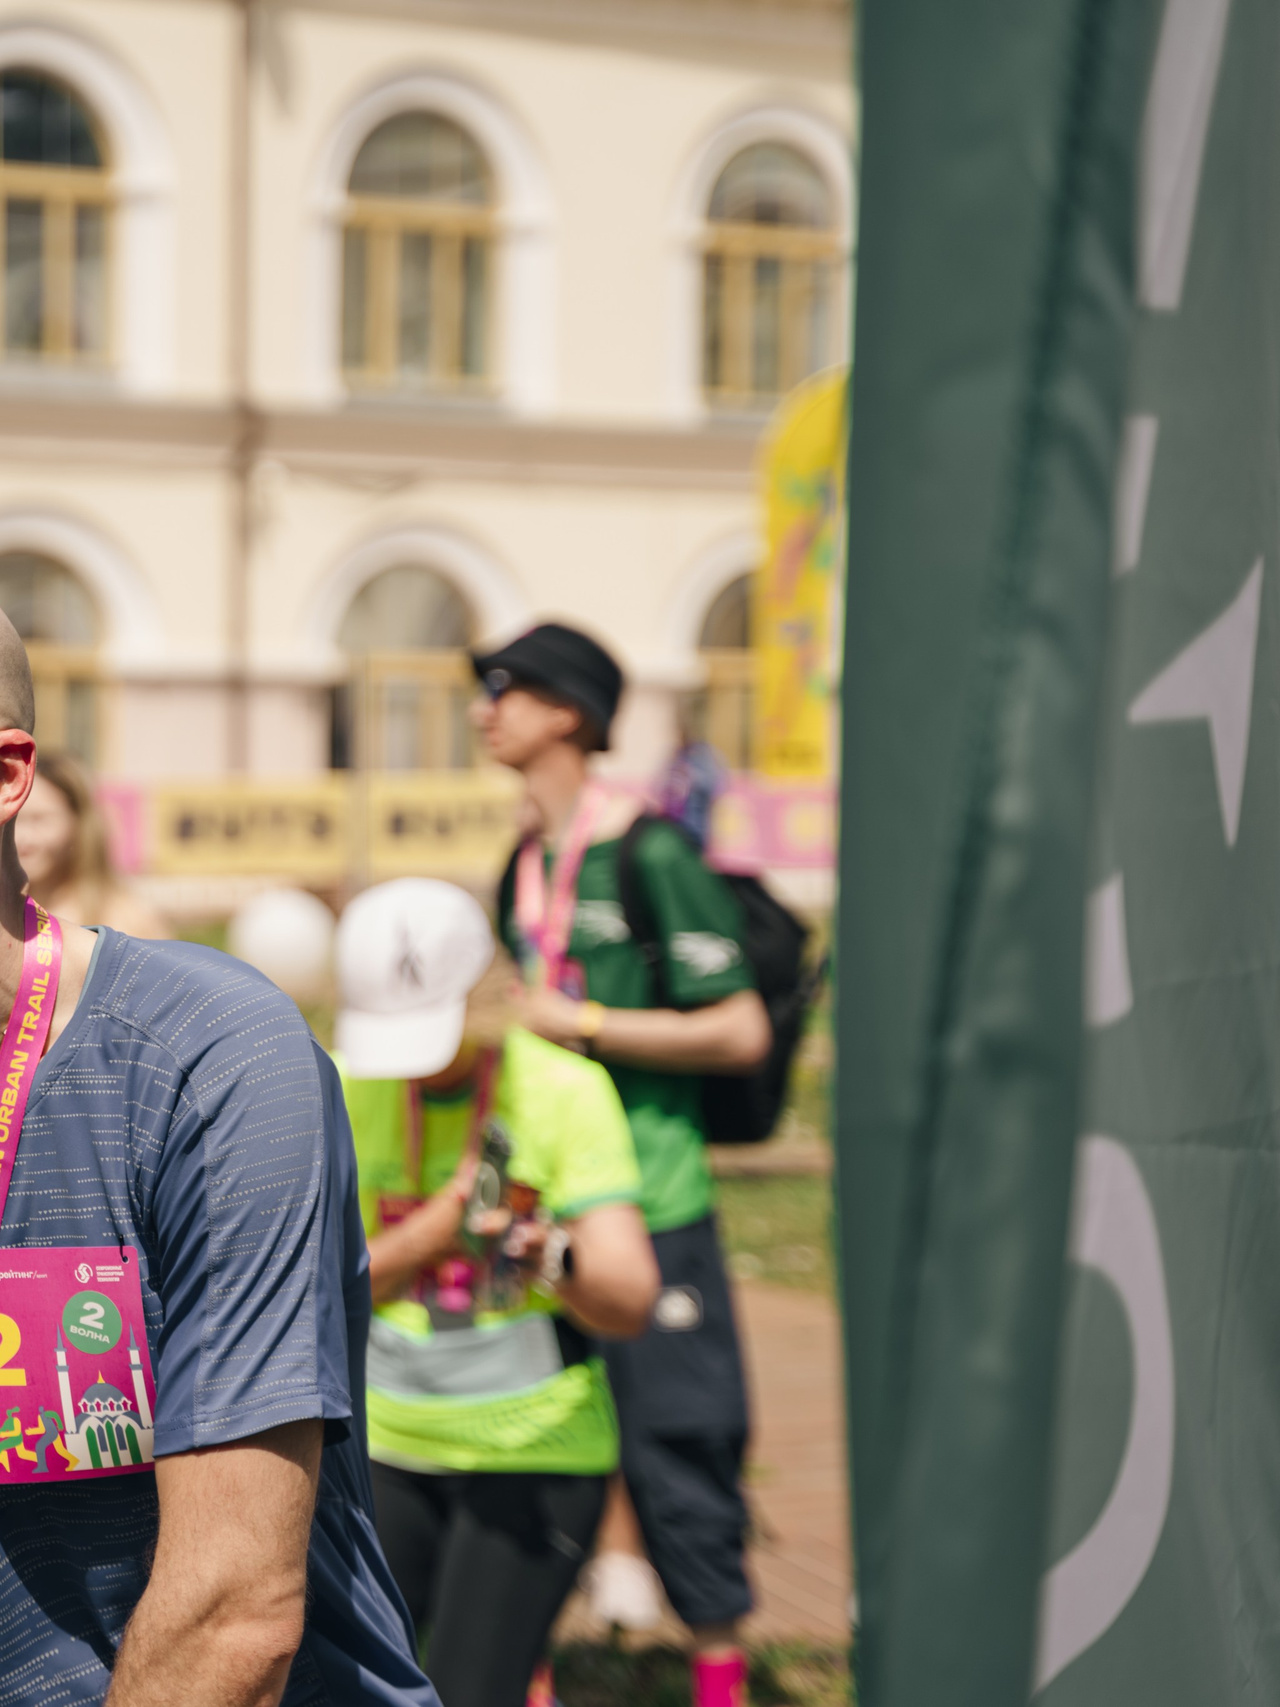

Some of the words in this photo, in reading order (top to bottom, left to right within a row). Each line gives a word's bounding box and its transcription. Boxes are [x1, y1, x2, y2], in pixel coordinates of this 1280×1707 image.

[16, 971, 50, 1045] TRAIL
[34, 902, 52, 967] SERIE
[79, 1301, 105, 1330] 2
[70, 1325, 110, 1344] ВОЛНА
